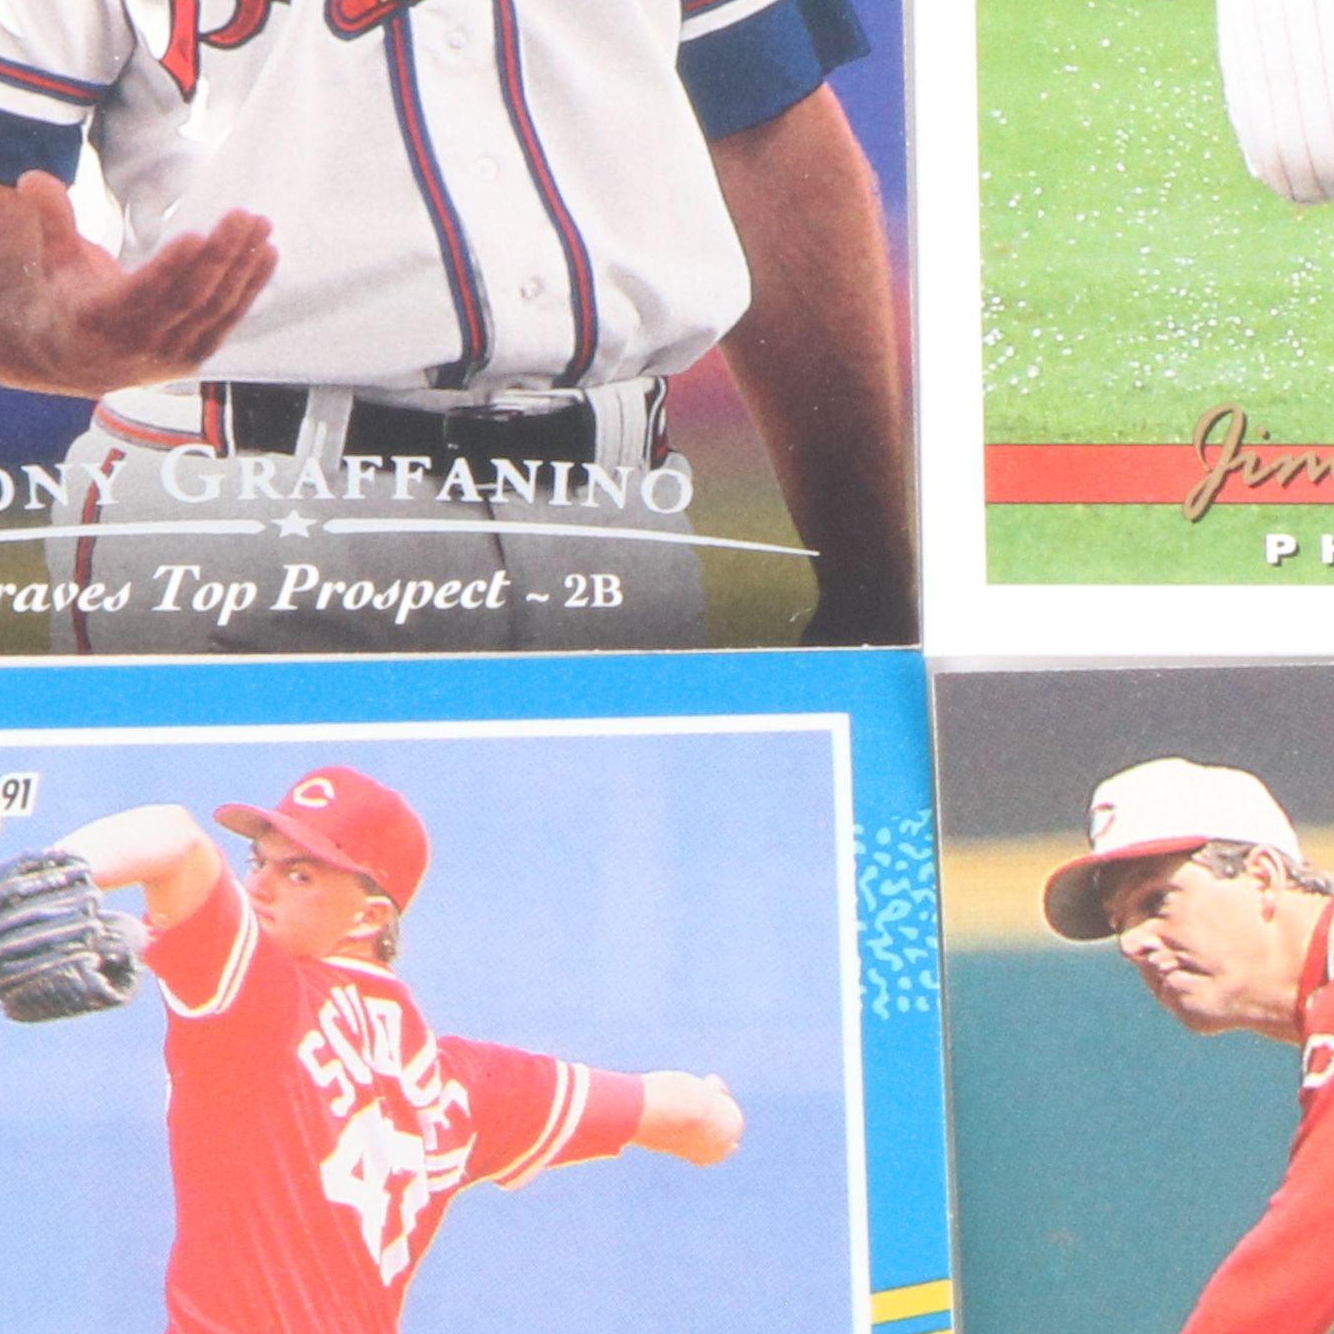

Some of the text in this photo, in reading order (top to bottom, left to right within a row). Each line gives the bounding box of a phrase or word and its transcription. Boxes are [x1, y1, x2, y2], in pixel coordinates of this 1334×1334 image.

[162, 444, 695, 516] GRAFFANINO
[152, 564, 257, 625] Top
[271, 564, 511, 625] Prospect
[564, 572, 624, 609] 2B
[2, 778, 32, 811] 91
